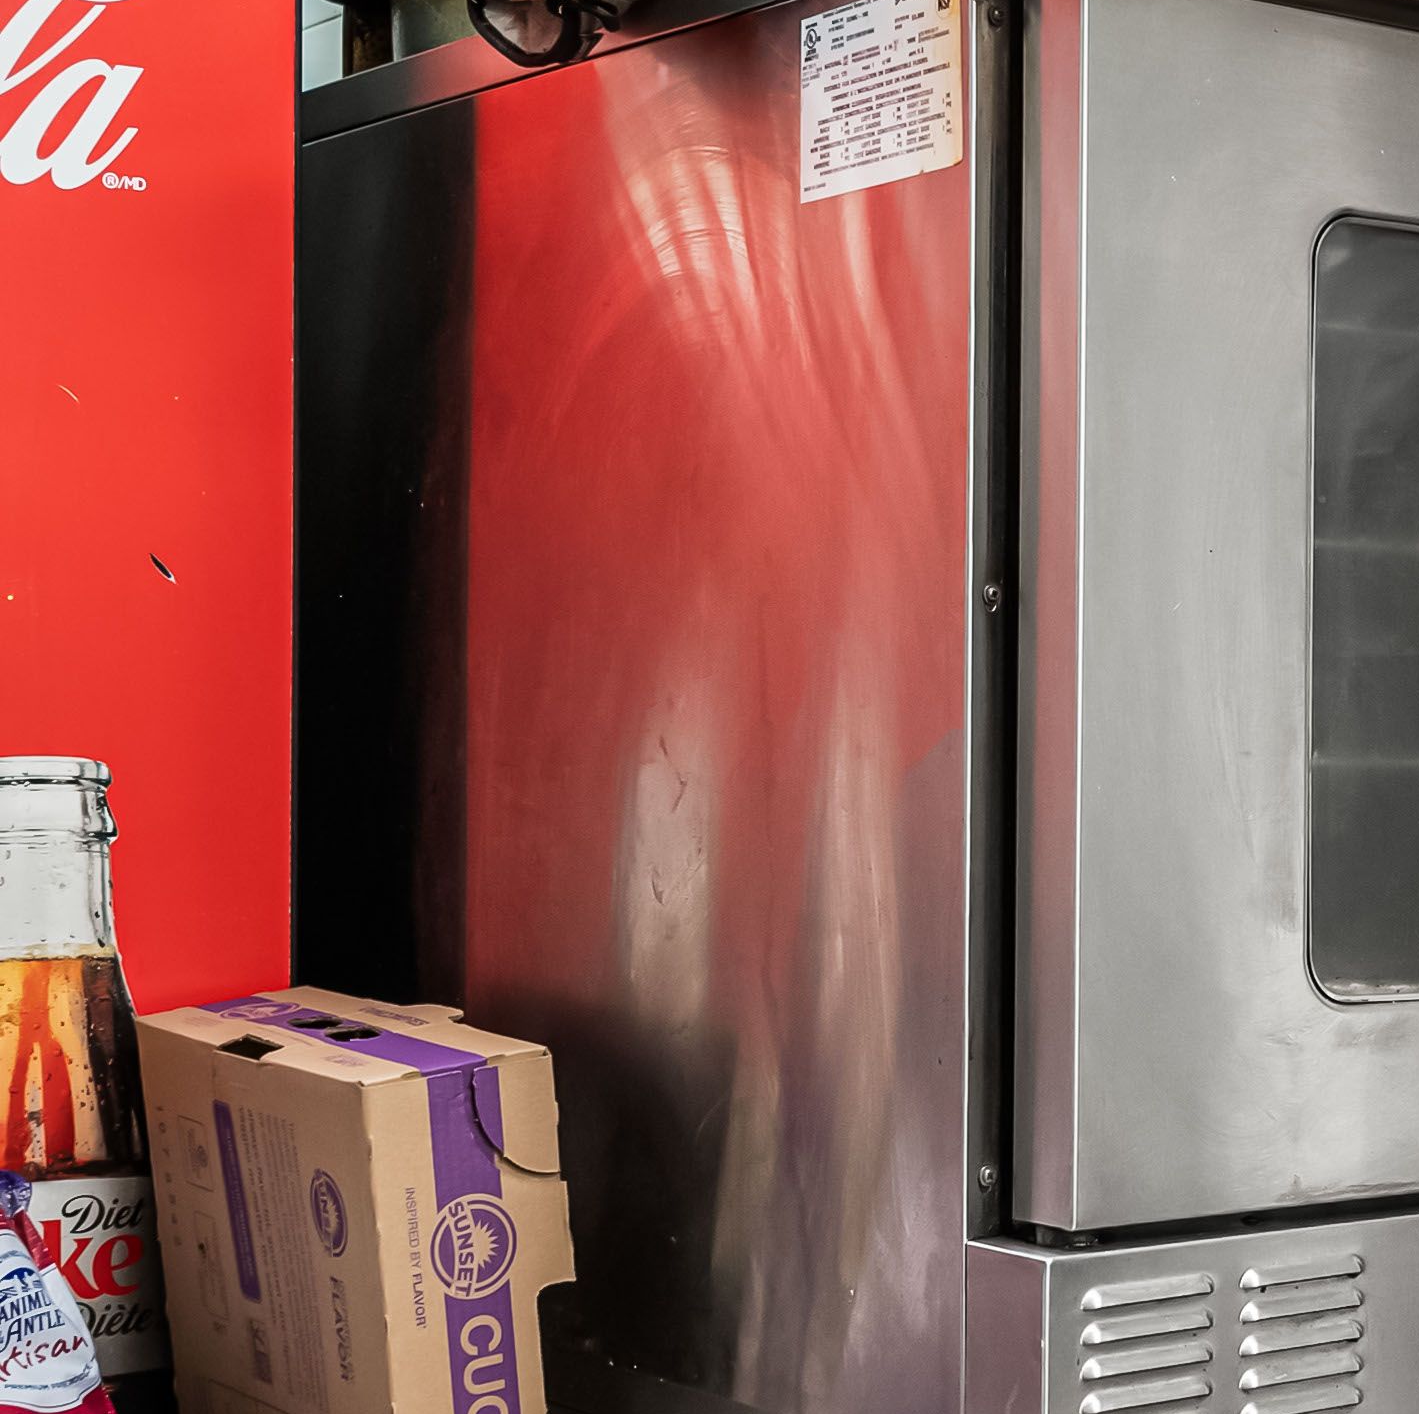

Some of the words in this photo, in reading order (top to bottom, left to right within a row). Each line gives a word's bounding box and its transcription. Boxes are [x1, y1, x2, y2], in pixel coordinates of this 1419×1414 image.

[61, 1193, 145, 1234] Diet
[405, 1186, 421, 1249] INSPIRED
[408, 1250, 422, 1270] BY
[448, 1200, 477, 1298] SUNSET
